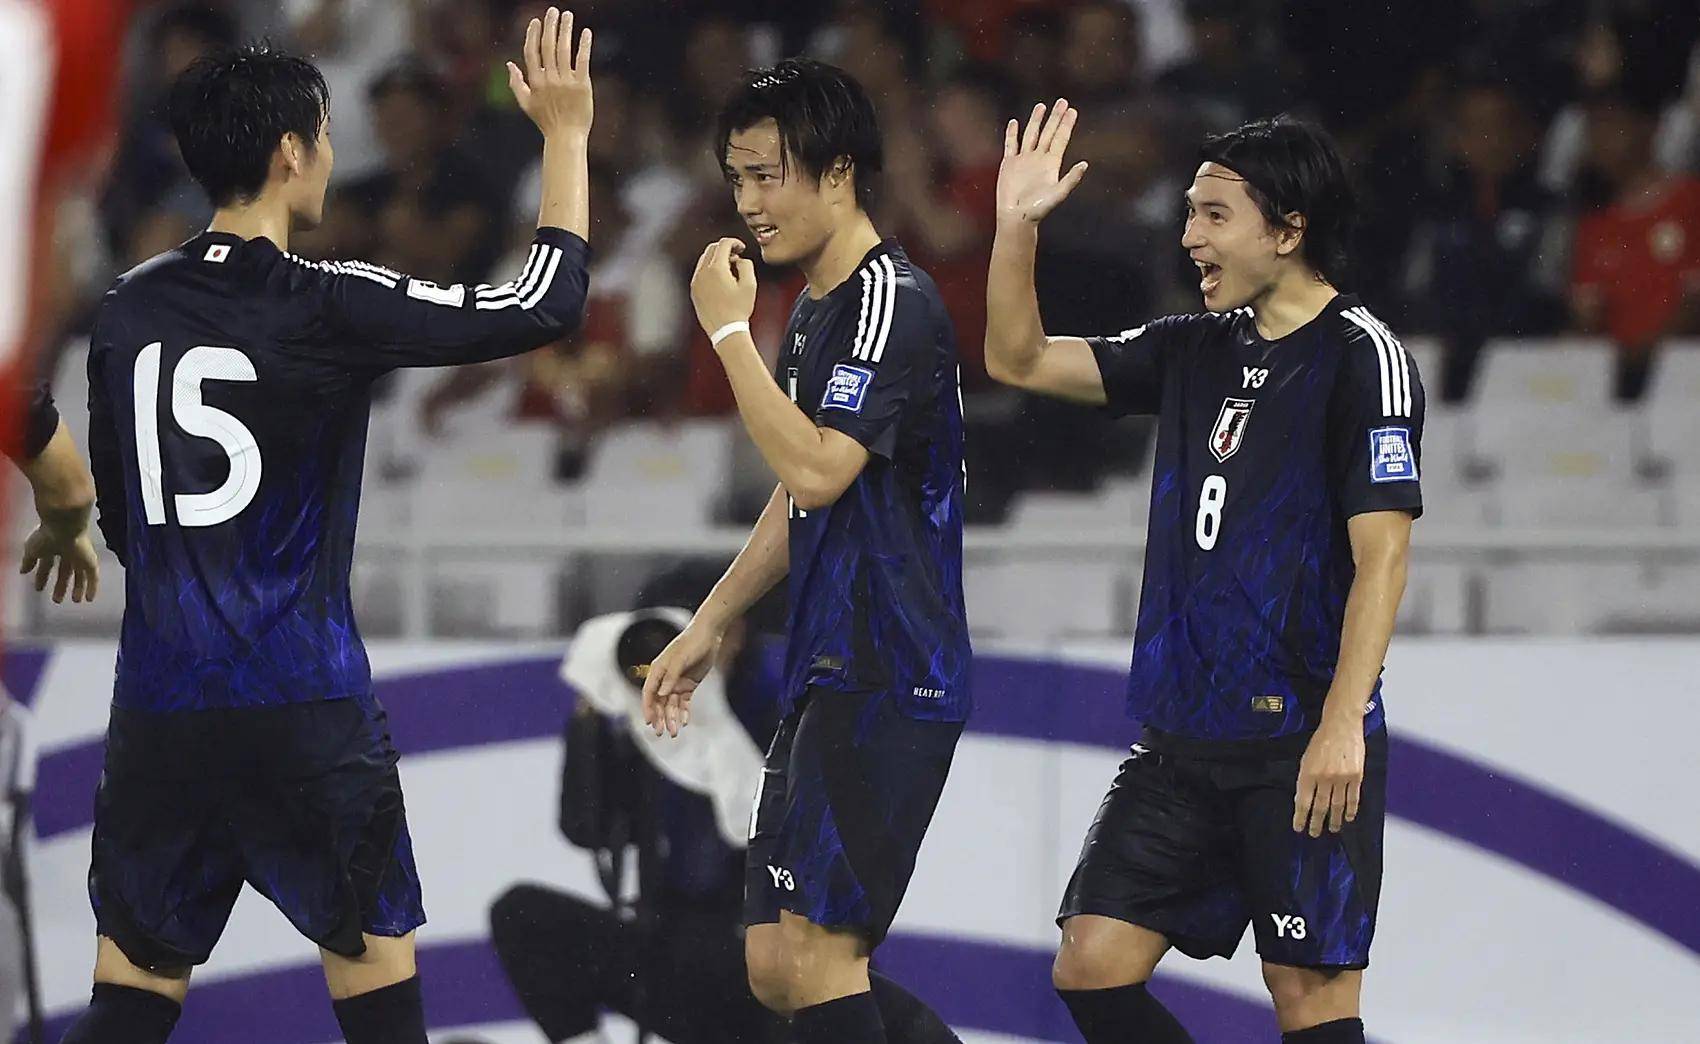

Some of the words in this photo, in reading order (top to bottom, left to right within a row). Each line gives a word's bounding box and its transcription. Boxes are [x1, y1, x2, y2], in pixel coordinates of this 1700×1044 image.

[833, 376, 860, 387] UNITES
[1242, 366, 1269, 389] Y-3
[133, 341, 263, 527] 15
[1379, 442, 1406, 454] UNITES
[1195, 475, 1227, 551] 8
[767, 864, 796, 892] Y-3
[1270, 913, 1307, 940] Y-3
